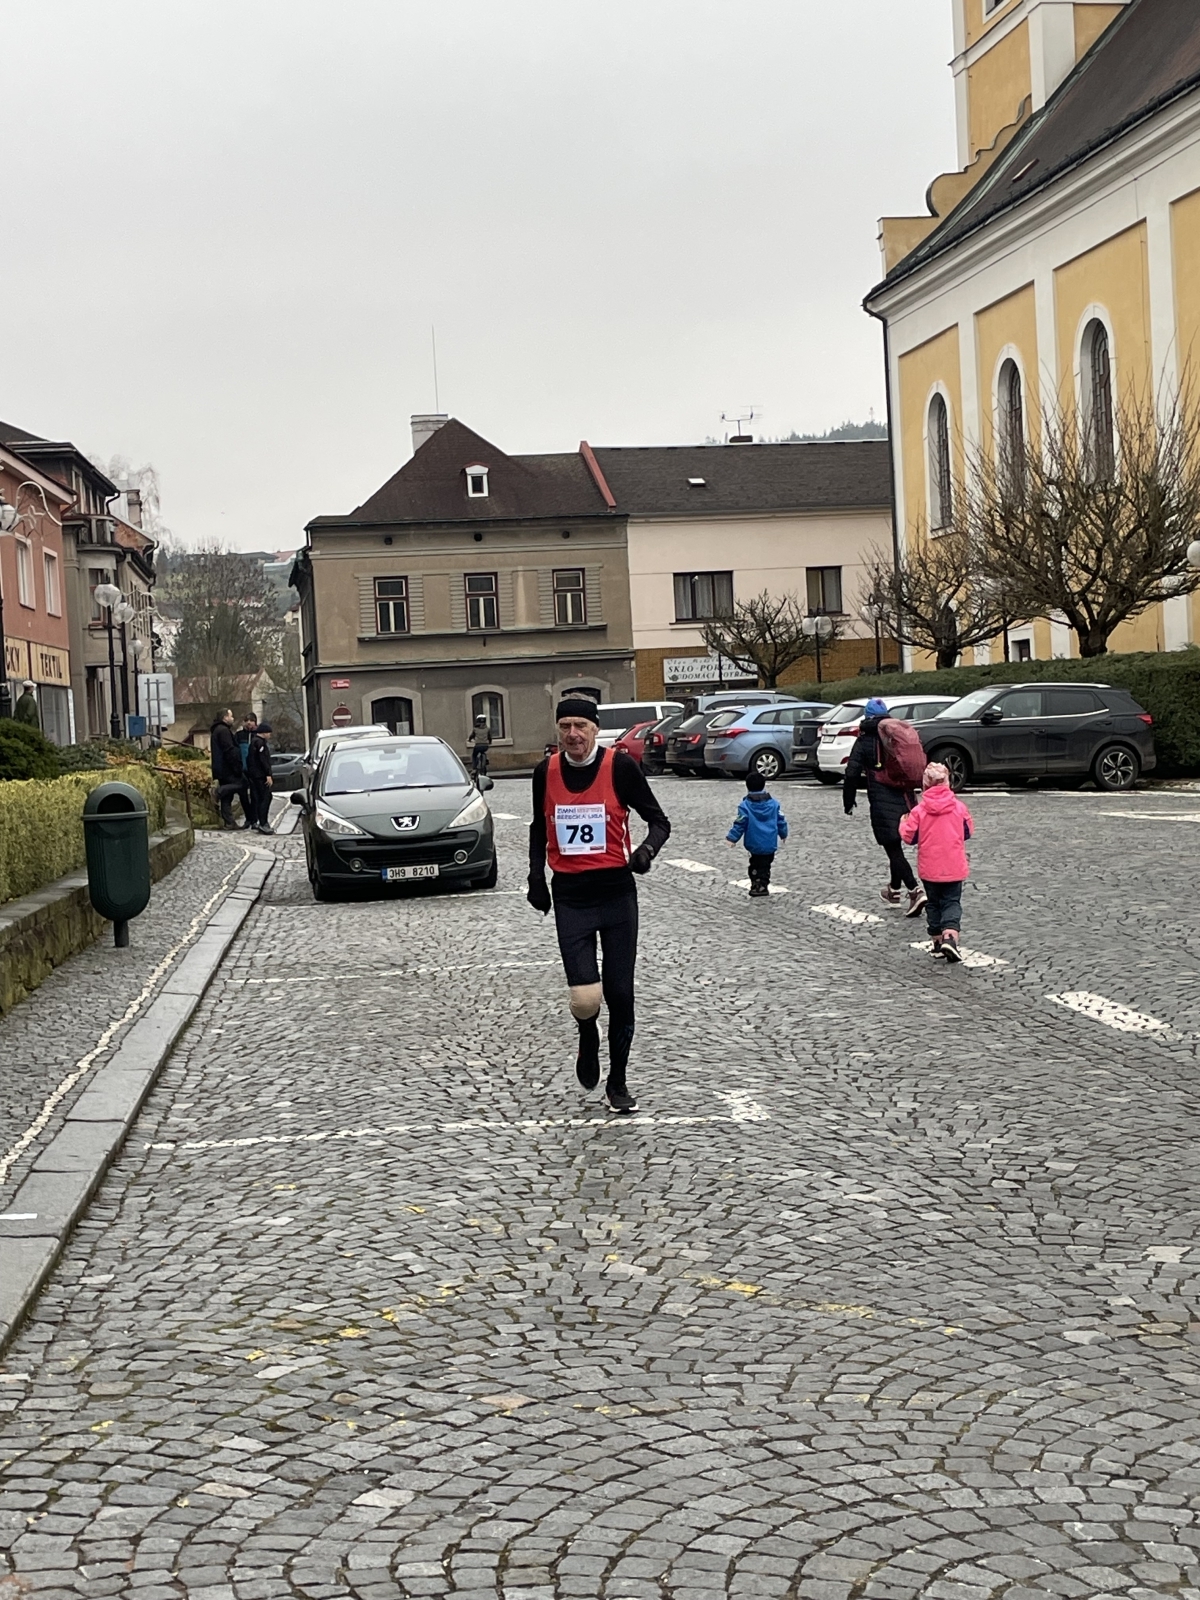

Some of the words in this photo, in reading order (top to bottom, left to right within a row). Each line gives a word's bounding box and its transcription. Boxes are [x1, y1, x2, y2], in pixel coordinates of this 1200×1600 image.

[40, 653, 62, 679] TEXTIL
[667, 665, 694, 674] SKLO
[682, 671, 716, 680] DOMÁCÍ
[566, 824, 594, 844] 78
[389, 868, 406, 878] 3H9
[412, 866, 435, 876] 8210
